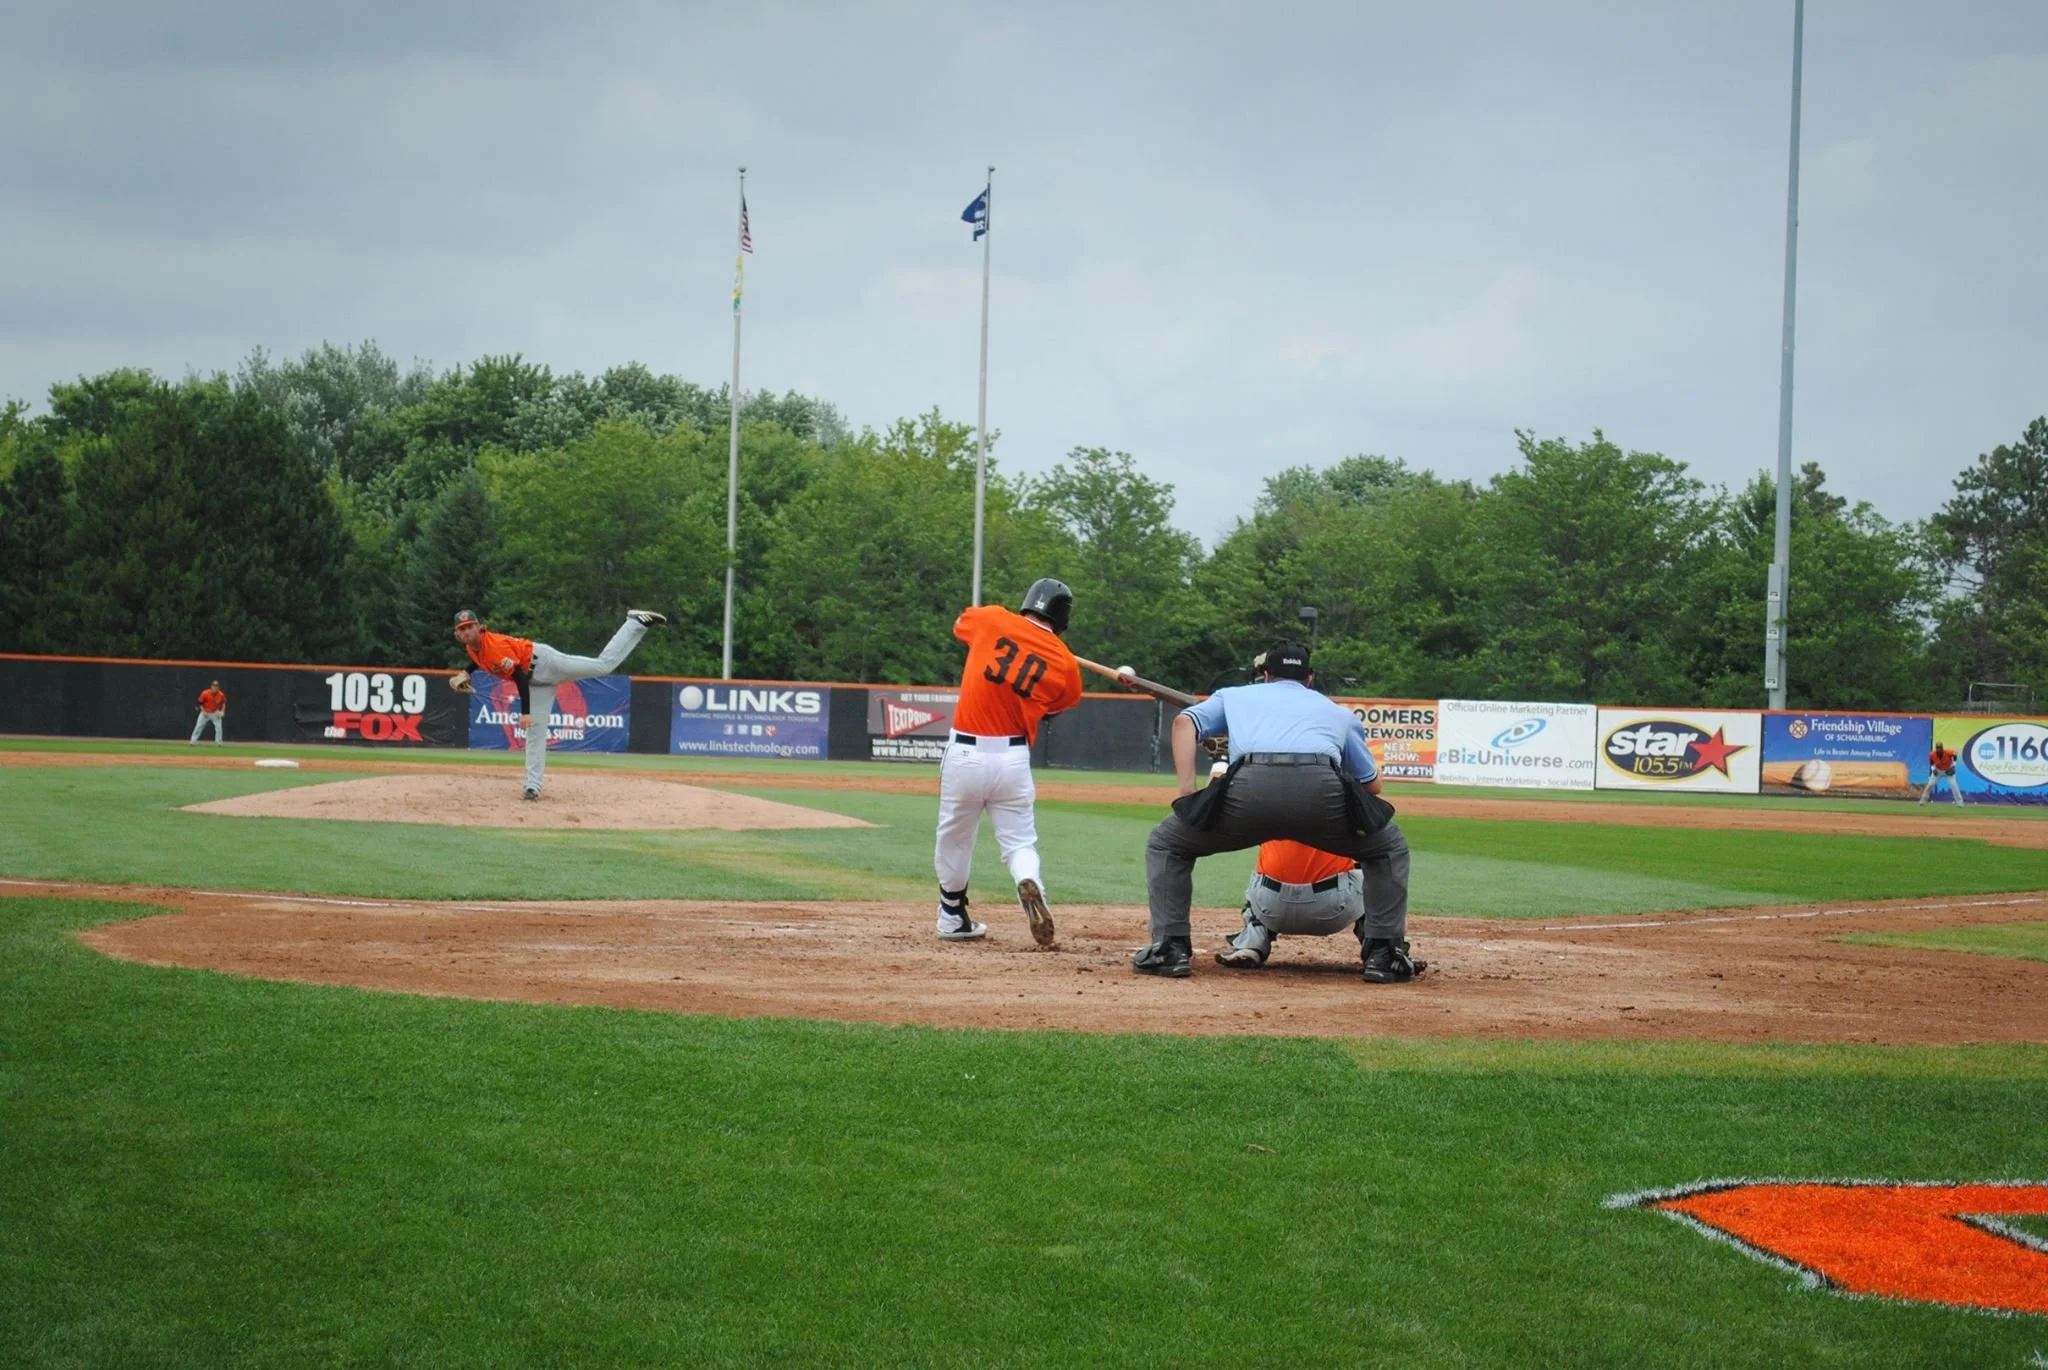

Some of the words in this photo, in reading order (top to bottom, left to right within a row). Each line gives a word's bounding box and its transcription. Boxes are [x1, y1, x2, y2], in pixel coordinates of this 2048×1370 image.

[984, 636, 1048, 698] 30
[325, 672, 427, 714] 103.9
[706, 688, 821, 714] LINKS
[1447, 702, 1478, 713] Official
[1479, 703, 1508, 714] Online
[1510, 704, 1554, 717] Marketing
[1555, 706, 1589, 716] Partner
[324, 725, 346, 738] the
[333, 711, 423, 742] FOX
[553, 728, 584, 740] SUITES
[1811, 719, 1865, 734] Friendship
[1866, 720, 1902, 736] Village
[1608, 724, 1699, 756] star
[1824, 733, 1834, 741] OF
[1836, 734, 1887, 743] SCHAUMBURG
[678, 740, 819, 757] www.linkstechnology.com
[1384, 742, 1412, 751] NEXT
[1384, 752, 1420, 762] SHOW:
[1633, 756, 1680, 774] 105.5
[1382, 764, 1405, 775] JULY
[1407, 765, 1433, 776] 25TH
[1505, 776, 1541, 785] Marketing
[1570, 778, 1592, 787] Media
